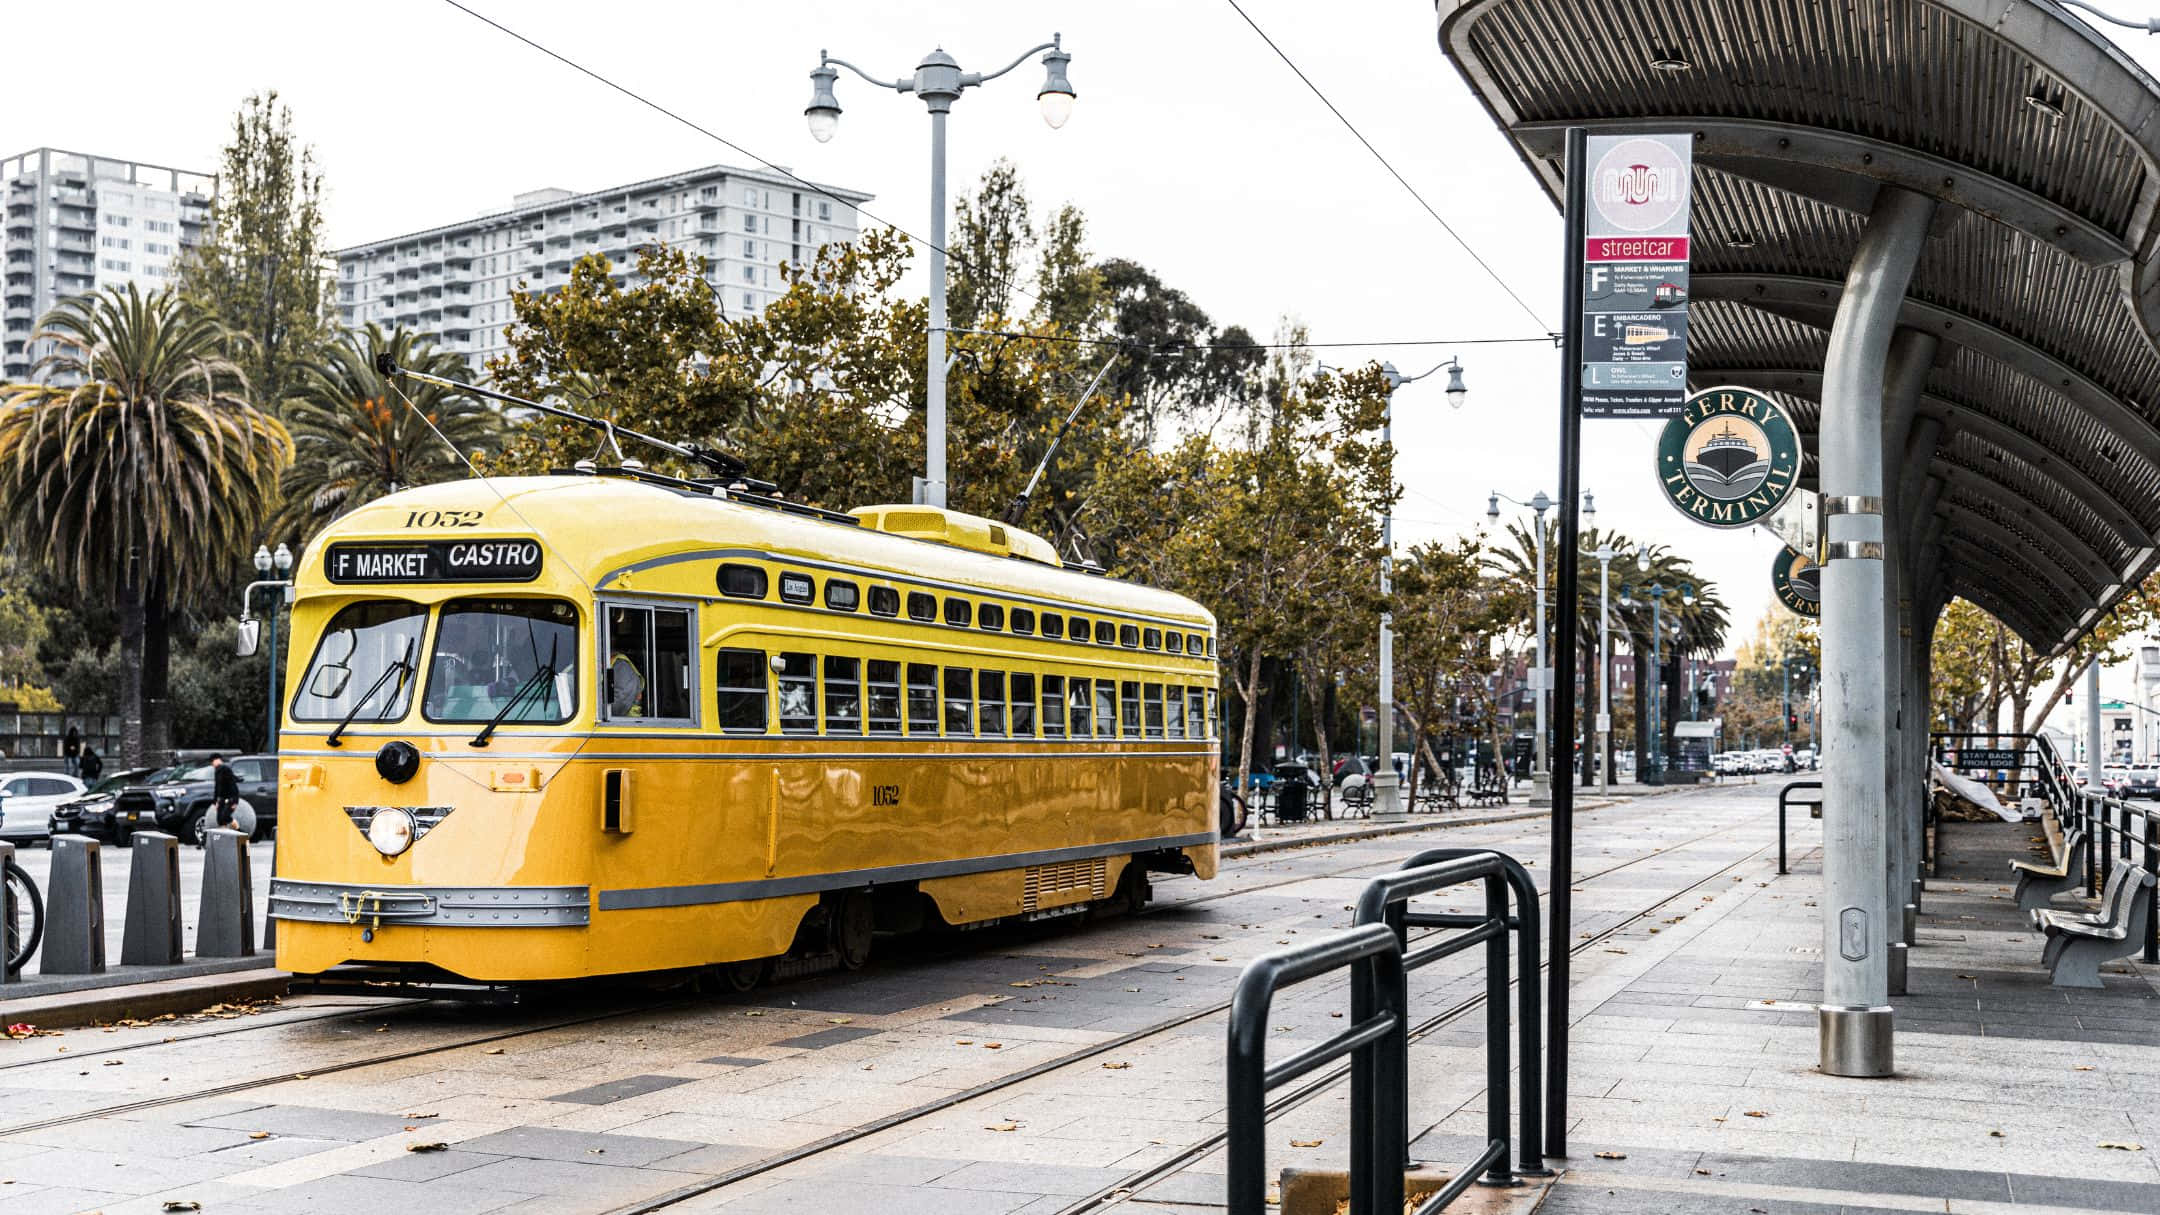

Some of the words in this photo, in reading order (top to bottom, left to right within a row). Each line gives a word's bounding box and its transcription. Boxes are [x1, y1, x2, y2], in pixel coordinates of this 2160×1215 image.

[1602, 240, 1674, 256] streetcar
[1592, 268, 1608, 292] F
[1594, 315, 1607, 337] E
[1592, 367, 1601, 384] L
[1684, 394, 1778, 426] FERRY
[1666, 465, 1791, 521] TERMINAL
[405, 511, 484, 528] 1052
[339, 555, 350, 577] F
[356, 554, 428, 577] MARKET
[449, 544, 538, 566] CASTRO
[1779, 583, 1820, 614] TERM
[872, 785, 899, 806] 1052
